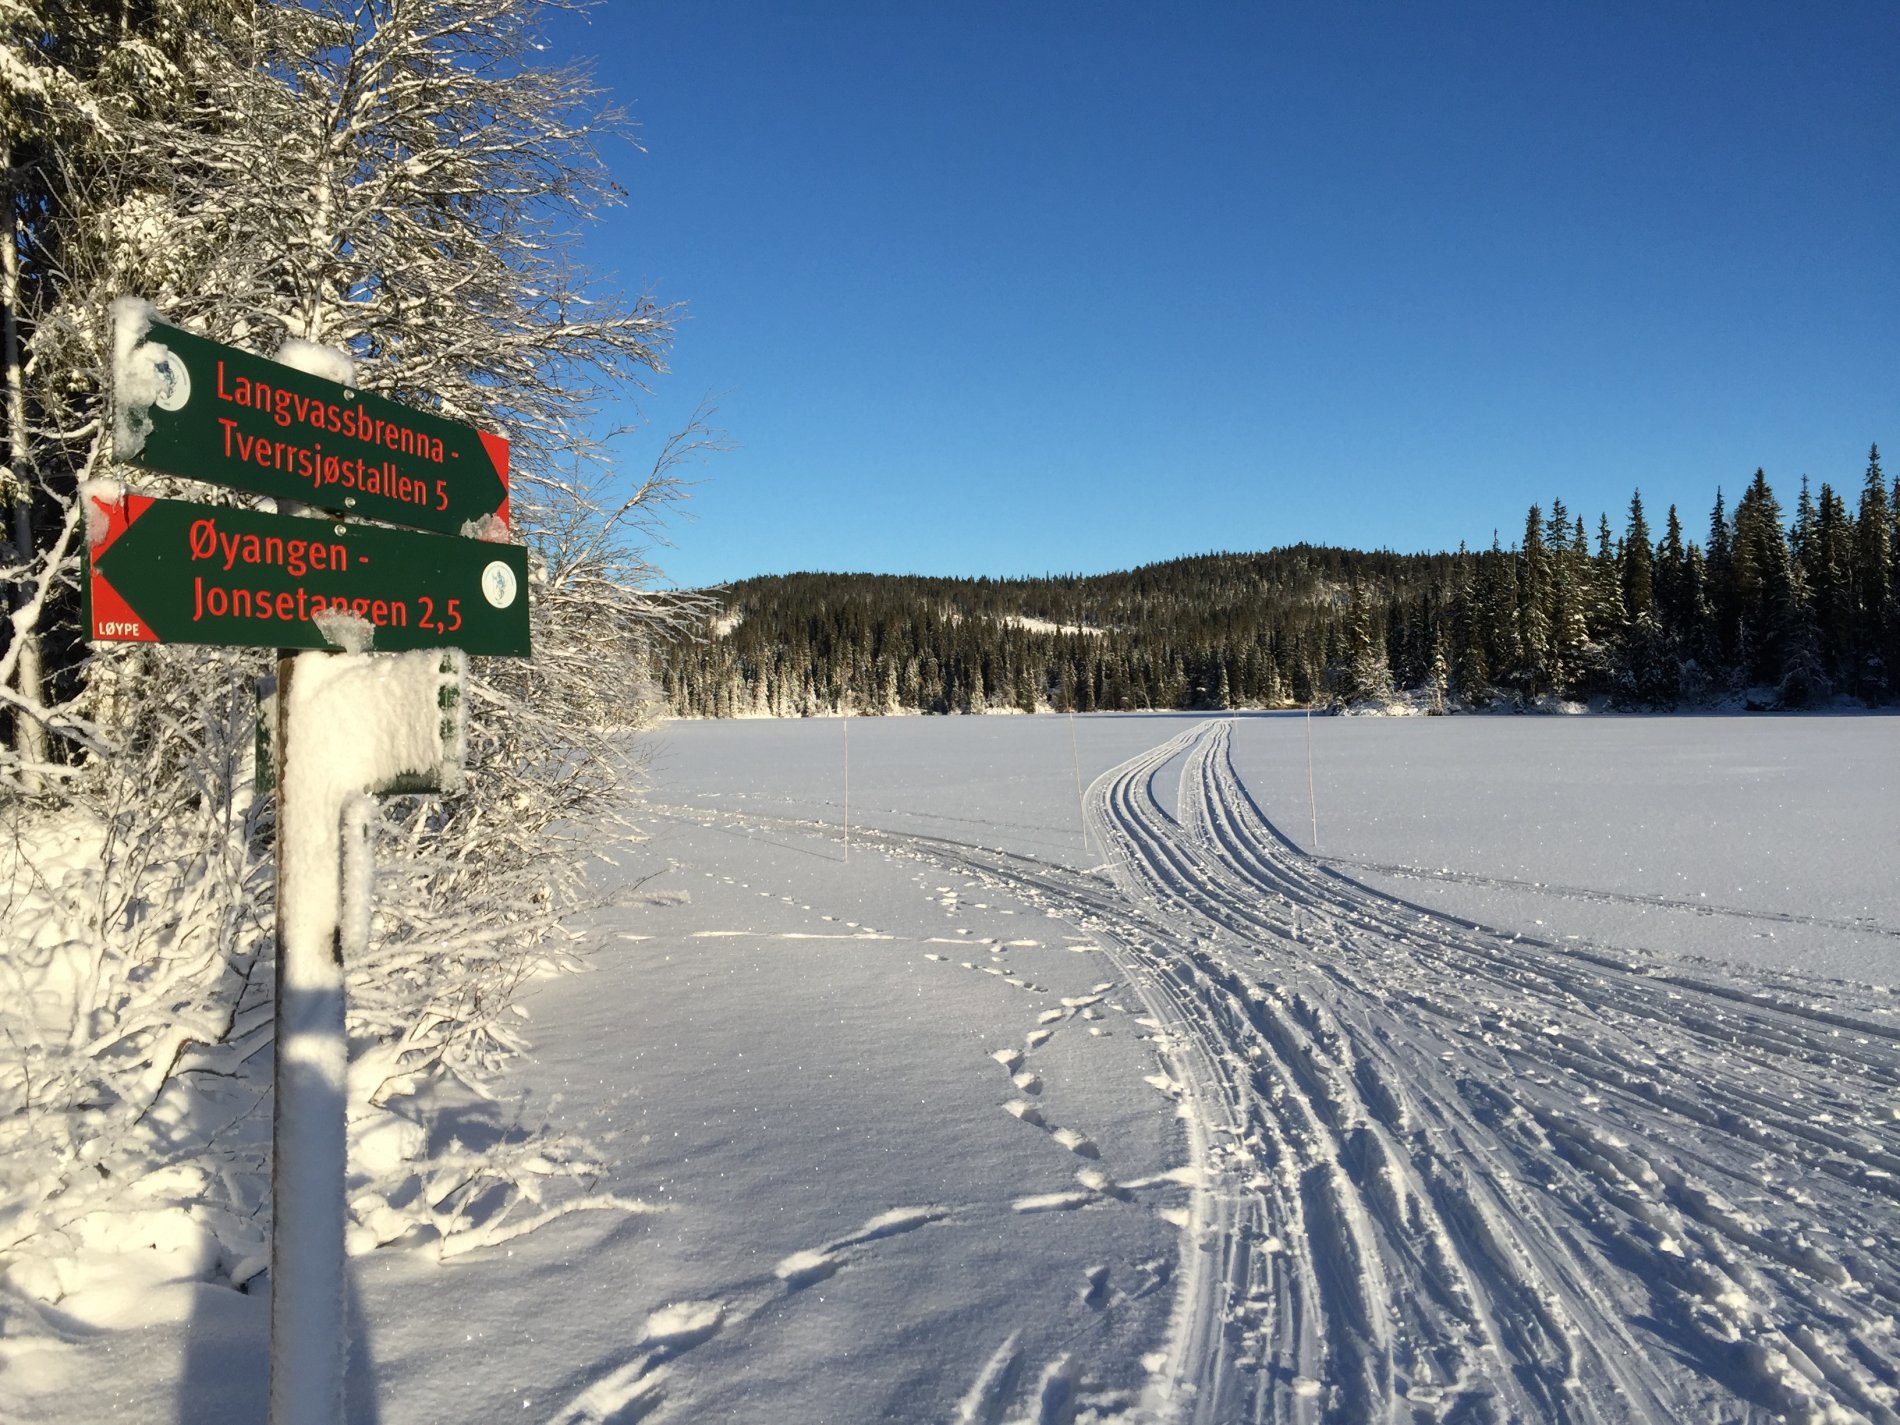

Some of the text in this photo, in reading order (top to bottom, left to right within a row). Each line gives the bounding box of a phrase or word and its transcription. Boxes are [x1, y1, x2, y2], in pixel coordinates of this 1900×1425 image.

[217, 360, 444, 463] Langvassbrenna
[218, 417, 448, 511] Tverrsjøstallen 5
[189, 518, 347, 577] Øyangen
[98, 621, 140, 637] LØYPE
[418, 596, 462, 634] 2,5
